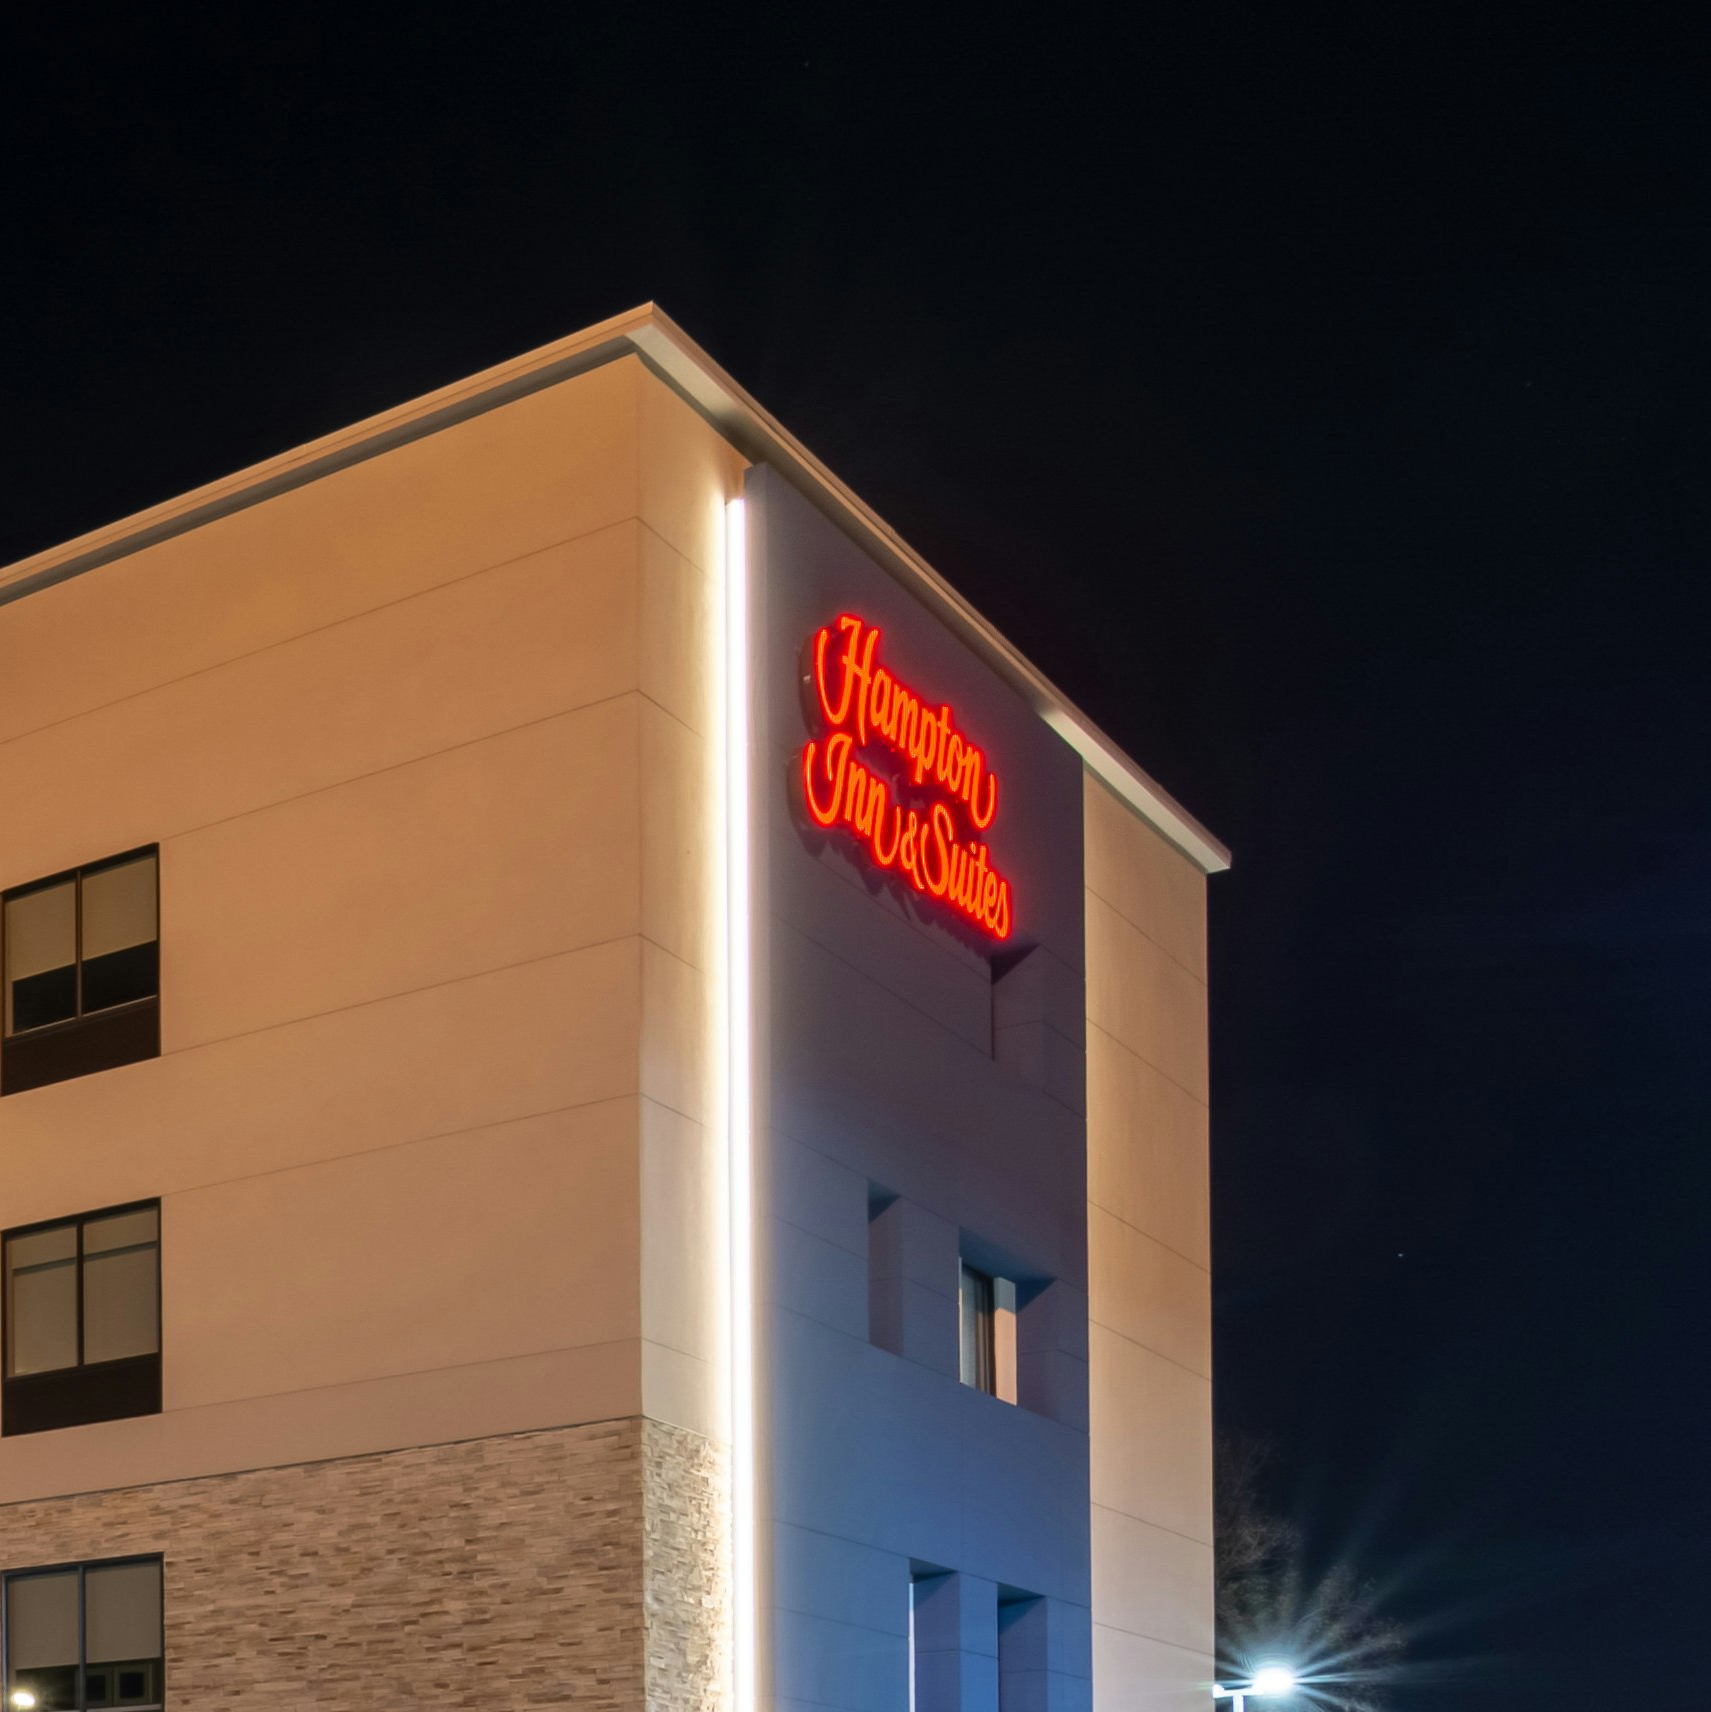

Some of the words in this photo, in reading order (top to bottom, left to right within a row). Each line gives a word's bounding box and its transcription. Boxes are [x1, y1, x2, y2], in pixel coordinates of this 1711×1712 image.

[814, 614, 997, 830] Hampton
[804, 731, 902, 866] Inn
[899, 810, 926, 891] &
[921, 802, 1011, 940] Suites
